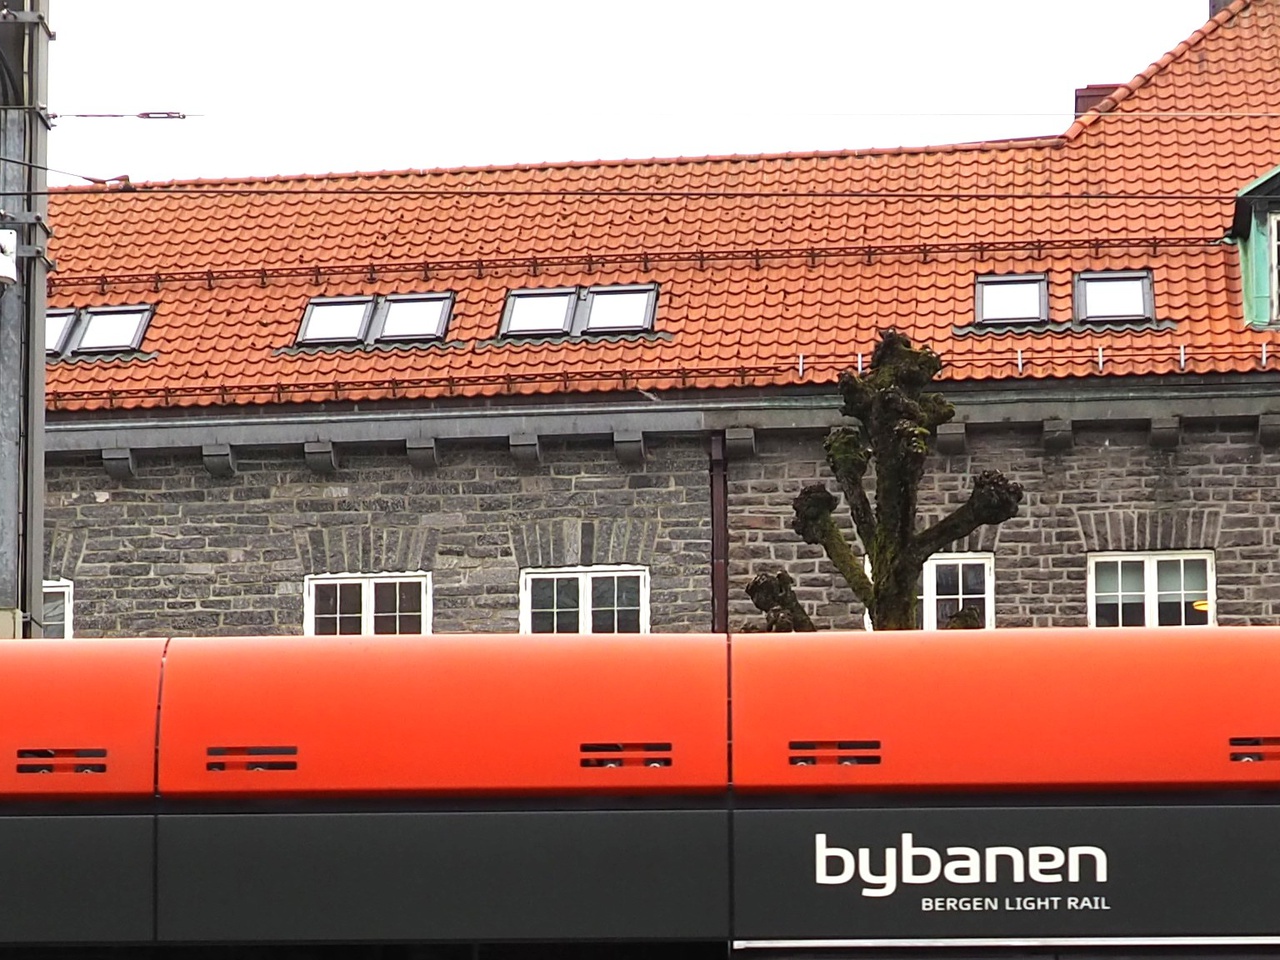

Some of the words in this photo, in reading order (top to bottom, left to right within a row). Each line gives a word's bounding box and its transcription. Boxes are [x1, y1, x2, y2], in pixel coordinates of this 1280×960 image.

[815, 833, 1108, 897] bybanen
[921, 896, 999, 911] BERGEN
[1005, 896, 1062, 911] LIGHT
[1067, 896, 1111, 910] RAIL
